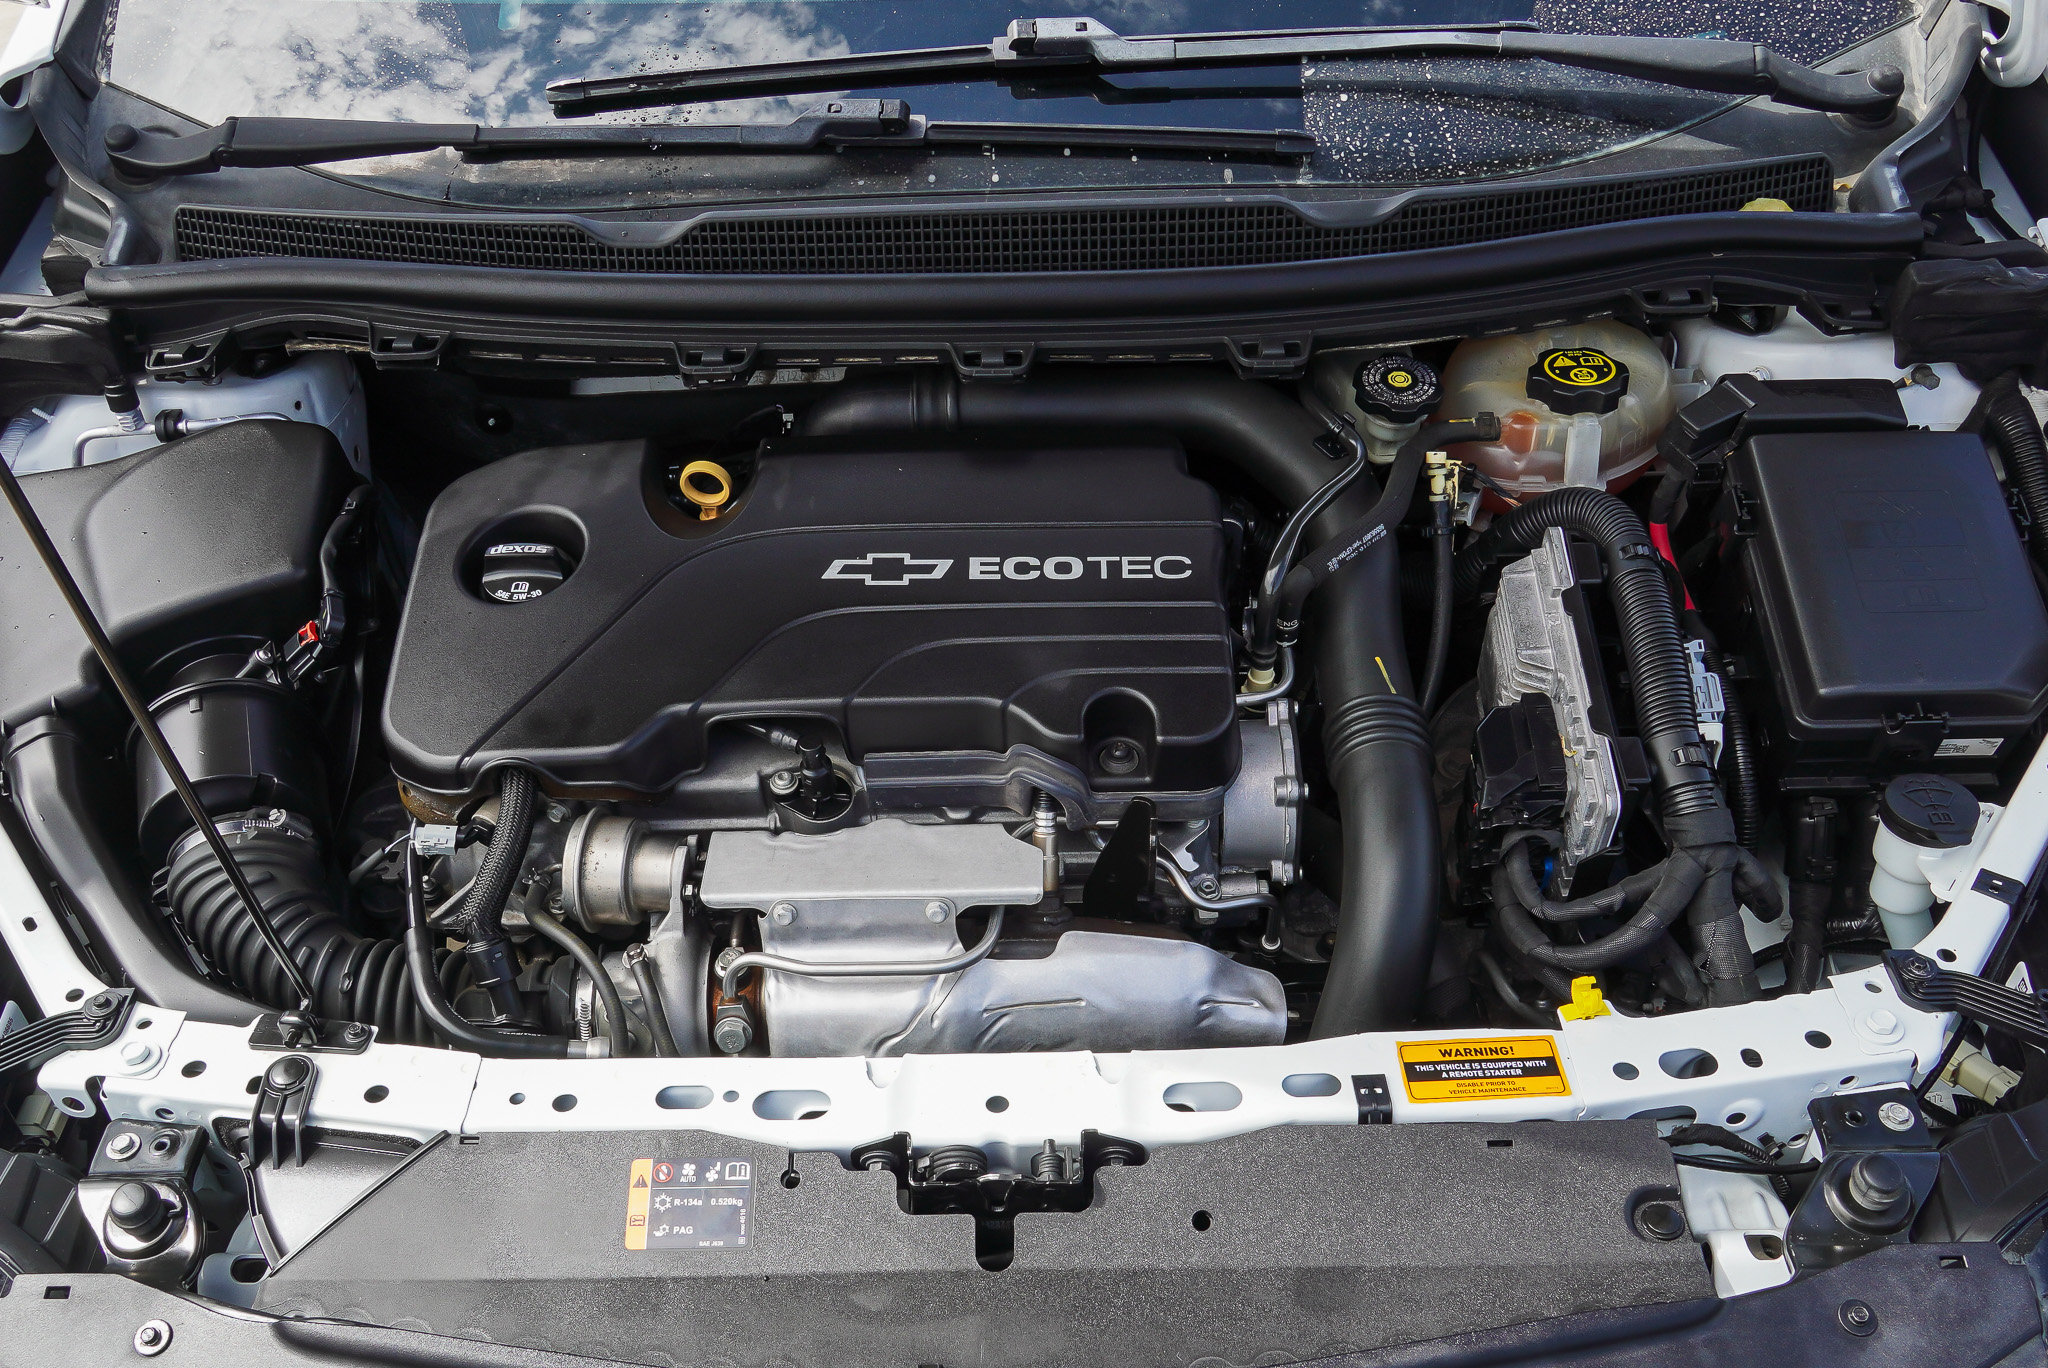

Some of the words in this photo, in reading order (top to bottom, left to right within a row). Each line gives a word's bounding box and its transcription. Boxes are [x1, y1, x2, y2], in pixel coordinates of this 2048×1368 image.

[490, 544, 548, 555] dexos
[968, 555, 1193, 581] ECOTEC
[495, 590, 512, 600] SAE
[512, 589, 542, 600] 5W-30
[1438, 1046, 1515, 1058] WARNING!
[1435, 1063, 1471, 1071] VEHICLE
[1482, 1060, 1523, 1069] EQUIPPED
[1449, 1070, 1484, 1078] REMOTE
[1484, 1068, 1523, 1077] STARTER
[1478, 1086, 1527, 1094] MAINTENANCE
[674, 1198, 703, 1206] R-134a
[710, 1198, 743, 1207] 0.520kg
[673, 1226, 694, 1235] PAG
